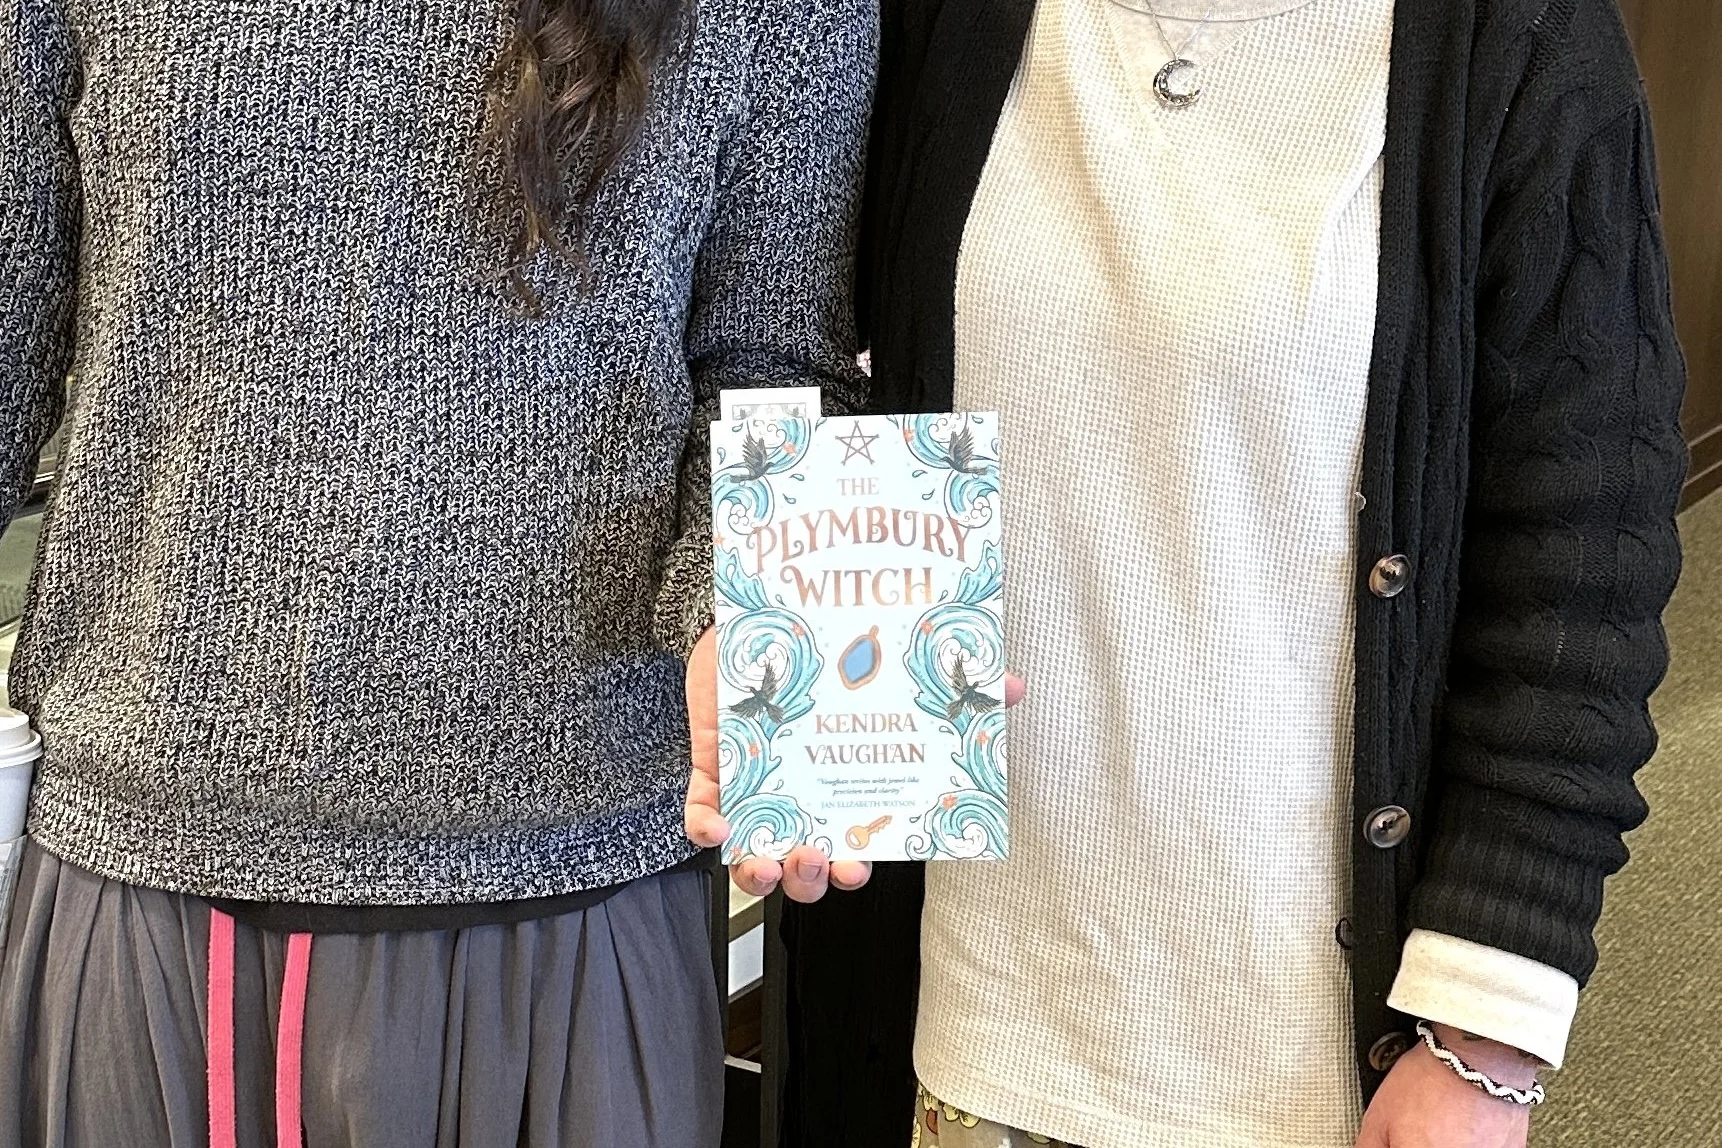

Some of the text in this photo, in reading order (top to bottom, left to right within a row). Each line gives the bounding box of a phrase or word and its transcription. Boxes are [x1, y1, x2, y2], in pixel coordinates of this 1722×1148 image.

[836, 476, 881, 496] THE
[746, 506, 971, 573] PLYMBURY
[780, 564, 933, 607] WITCH
[815, 712, 918, 734] KENDRA
[804, 743, 927, 764] VAUGHAN
[837, 800, 880, 808] ELIZABETH
